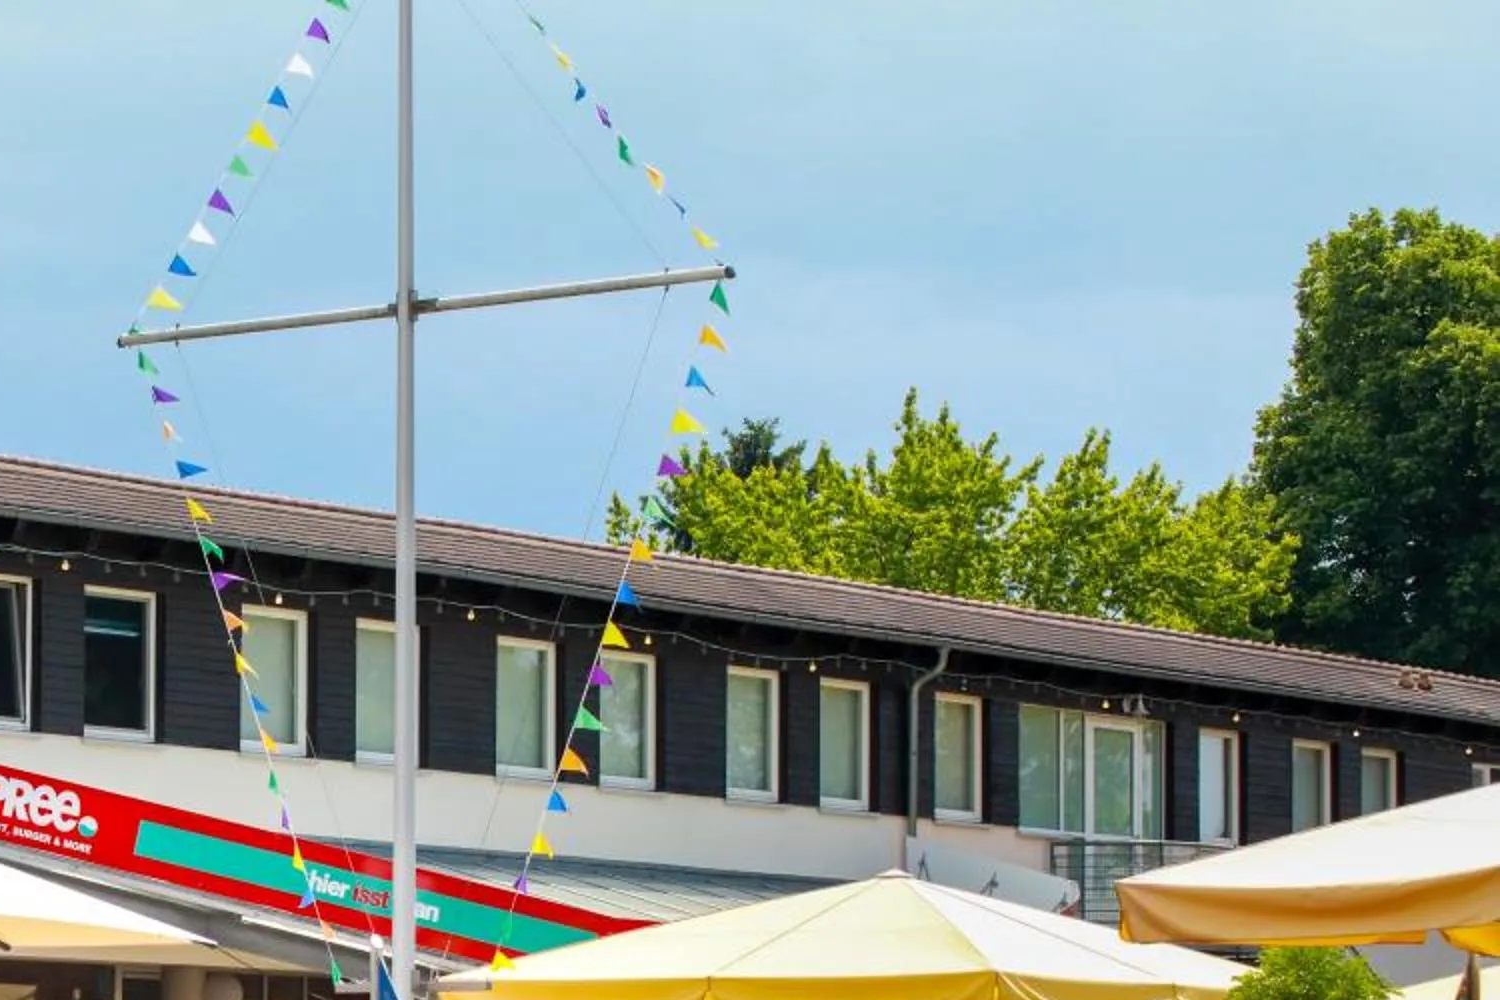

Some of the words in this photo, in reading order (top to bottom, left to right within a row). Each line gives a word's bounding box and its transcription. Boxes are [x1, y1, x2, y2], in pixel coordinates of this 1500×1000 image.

[308, 869, 350, 899] hier
[353, 880, 389, 909] isst
[412, 901, 440, 923] an
